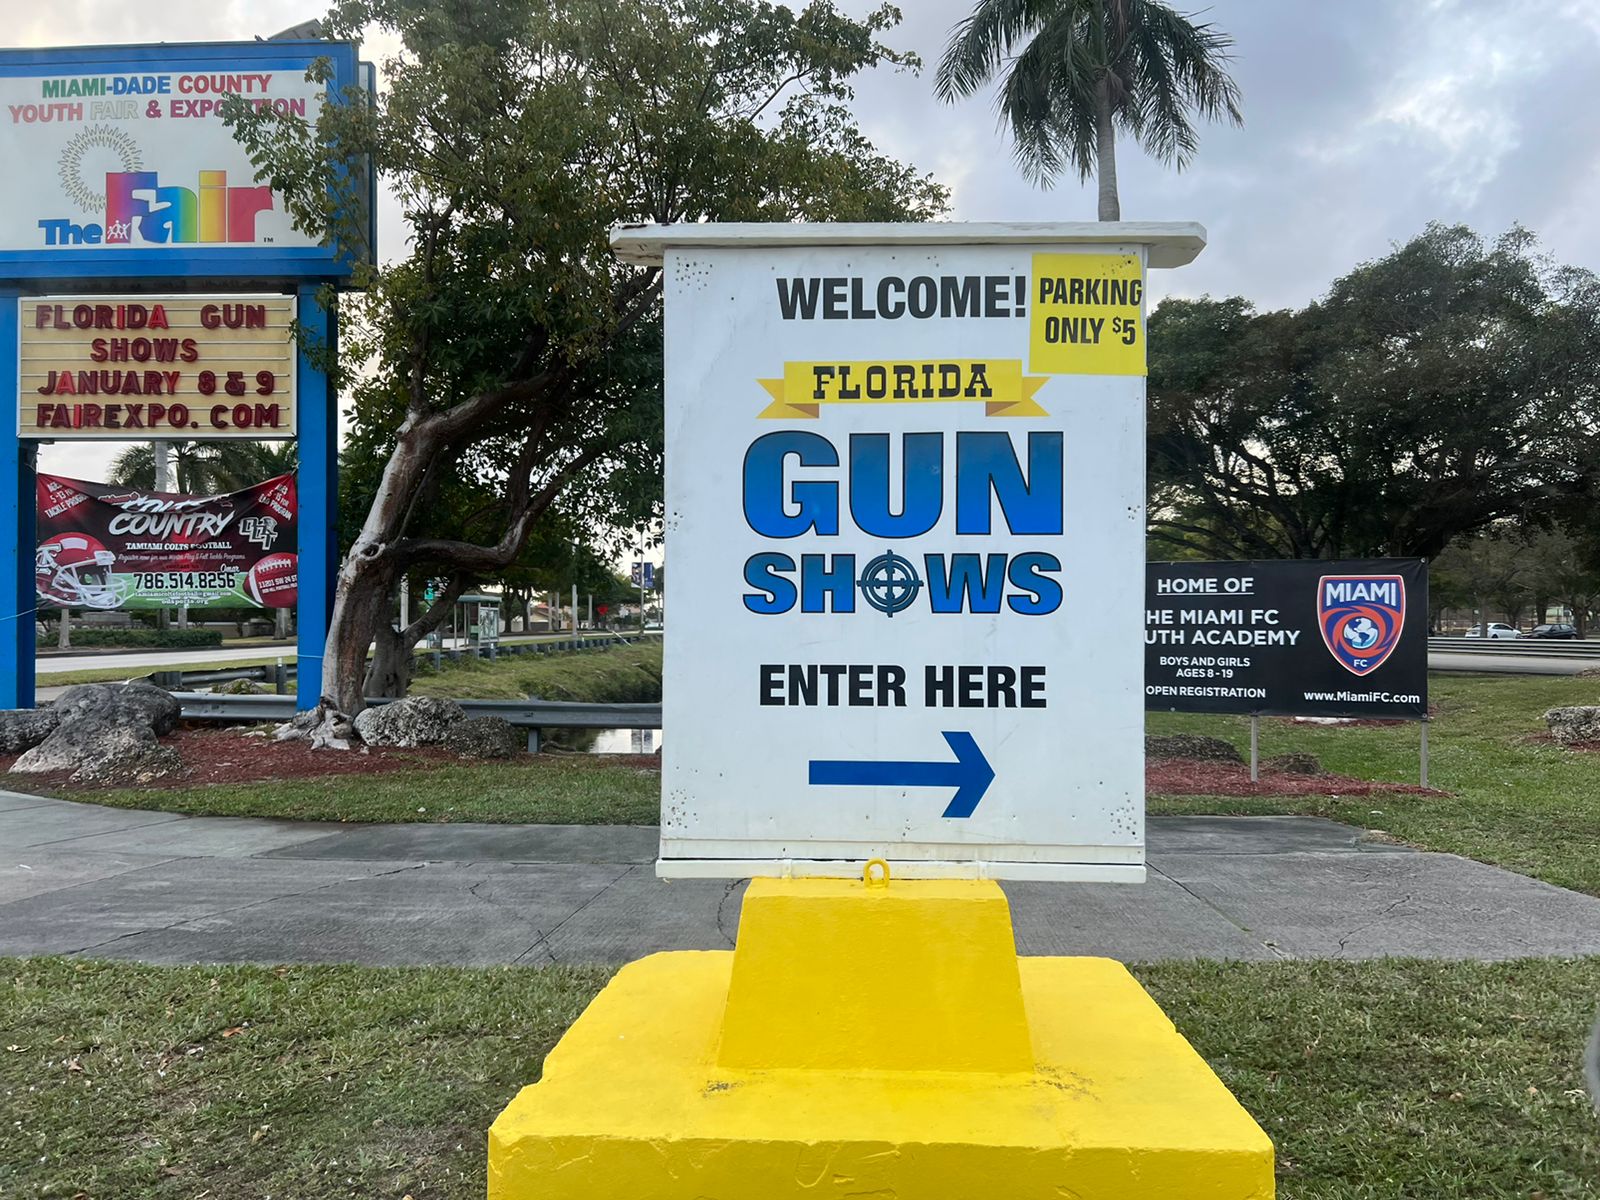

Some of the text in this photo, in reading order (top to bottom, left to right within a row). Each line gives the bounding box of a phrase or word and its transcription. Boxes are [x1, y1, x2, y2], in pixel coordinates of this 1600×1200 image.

[42, 74, 272, 98] MIAMI-DADE COUNTY
[8, 102, 83, 123] YOUTH
[90, 101, 139, 120] FAIR
[145, 99, 162, 119] &
[38, 170, 274, 245] The Fair
[776, 275, 1026, 320] WELCOME!
[1039, 277, 1142, 306] PARKING
[36, 304, 265, 330] FLORIDA GUN
[1045, 316, 1136, 345] ONLY $5
[90, 337, 199, 362] SHOWS
[37, 370, 275, 396] JANUARY 8 & 9
[813, 363, 993, 400] FLORIDA
[742, 430, 1064, 539] GUN
[108, 510, 235, 541] COUNTRY
[125, 542, 163, 550] TAMIAMI
[164, 542, 190, 551] COLTS
[132, 572, 237, 590] 786.514.8256
[1158, 577, 1254, 593] HOME OF
[1326, 582, 1397, 606] MIAMI
[1145, 609, 1279, 625] HE MIAMI FC
[1191, 630, 1301, 645] ACADEMY
[1160, 656, 1251, 667] BOYS AND GIRLS
[1176, 668, 1206, 678] AGES
[1207, 668, 1214, 678] 8
[1222, 669, 1234, 678] 19
[1353, 659, 1368, 667] FC
[760, 664, 1047, 708] ENTER HERE
[1145, 685, 1266, 698] OPEN REGISTRATION
[1304, 691, 1420, 703] www.MiamiFC.com
